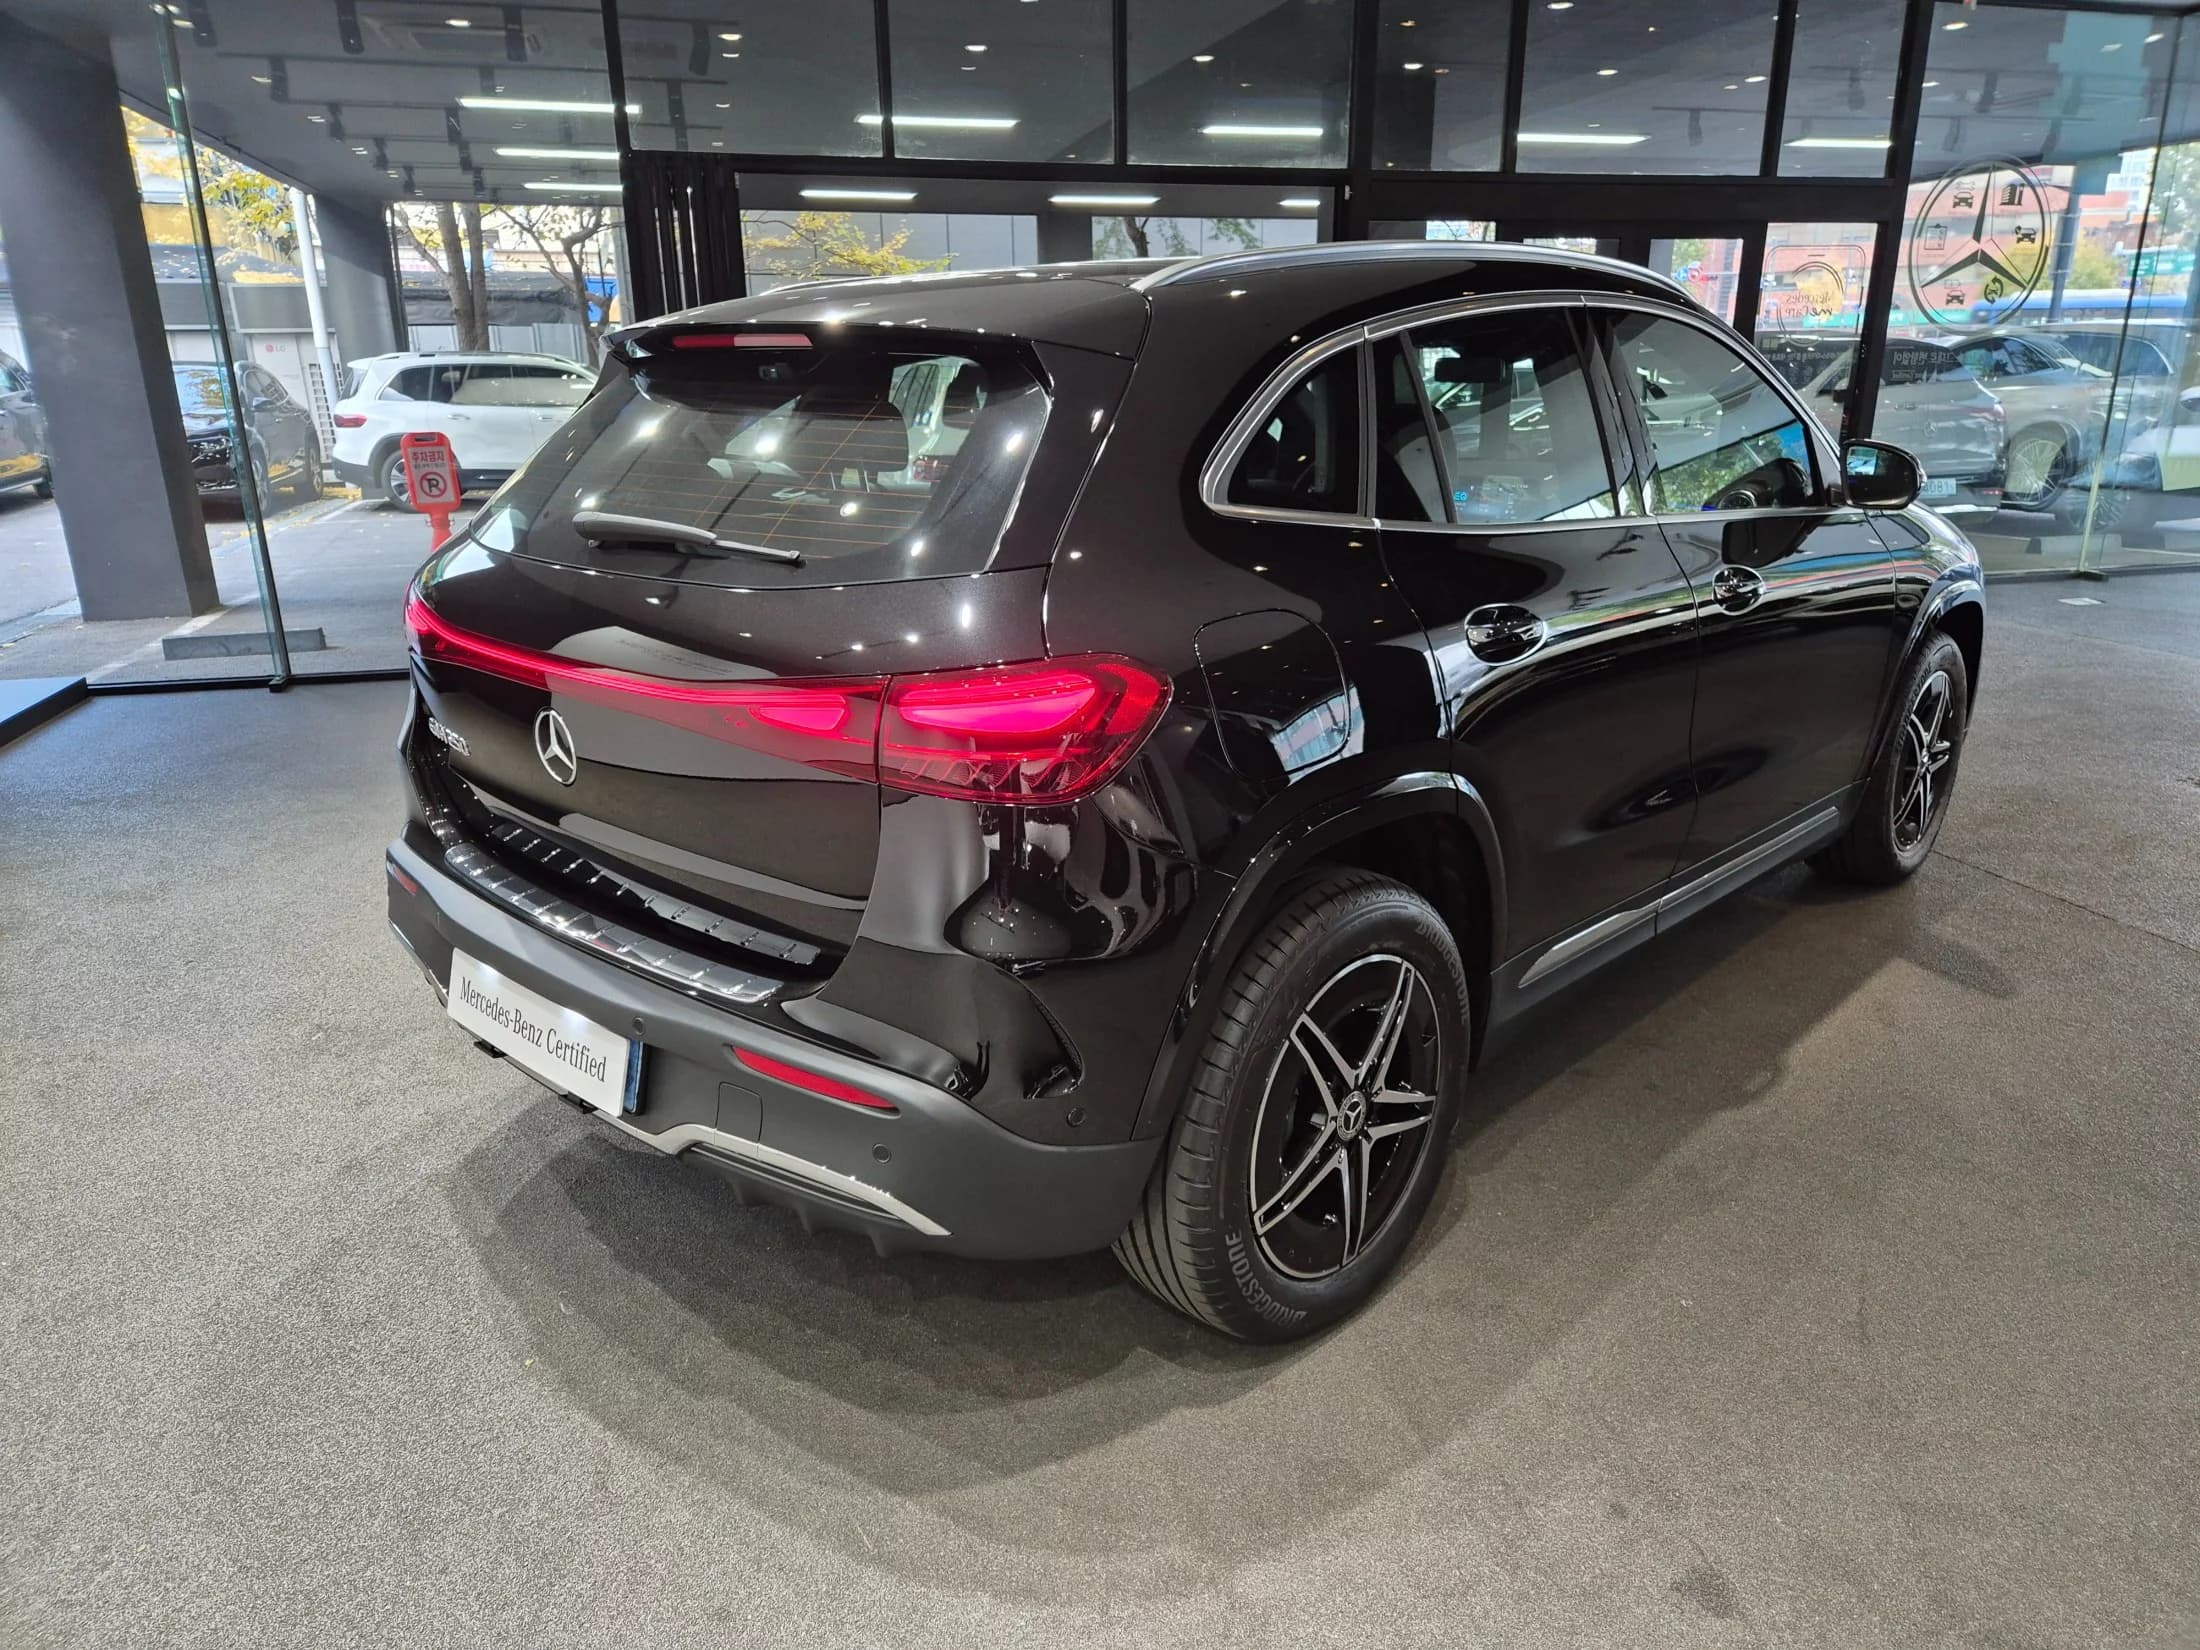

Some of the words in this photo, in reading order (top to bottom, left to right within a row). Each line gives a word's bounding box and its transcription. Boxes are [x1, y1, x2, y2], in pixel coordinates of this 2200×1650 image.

[412, 450, 445, 464] 주차금지
[460, 976, 543, 1048] Mercedes-Benz
[546, 1028, 607, 1083] Certified
[1224, 1228, 1308, 1328] BRIDGESTONE
